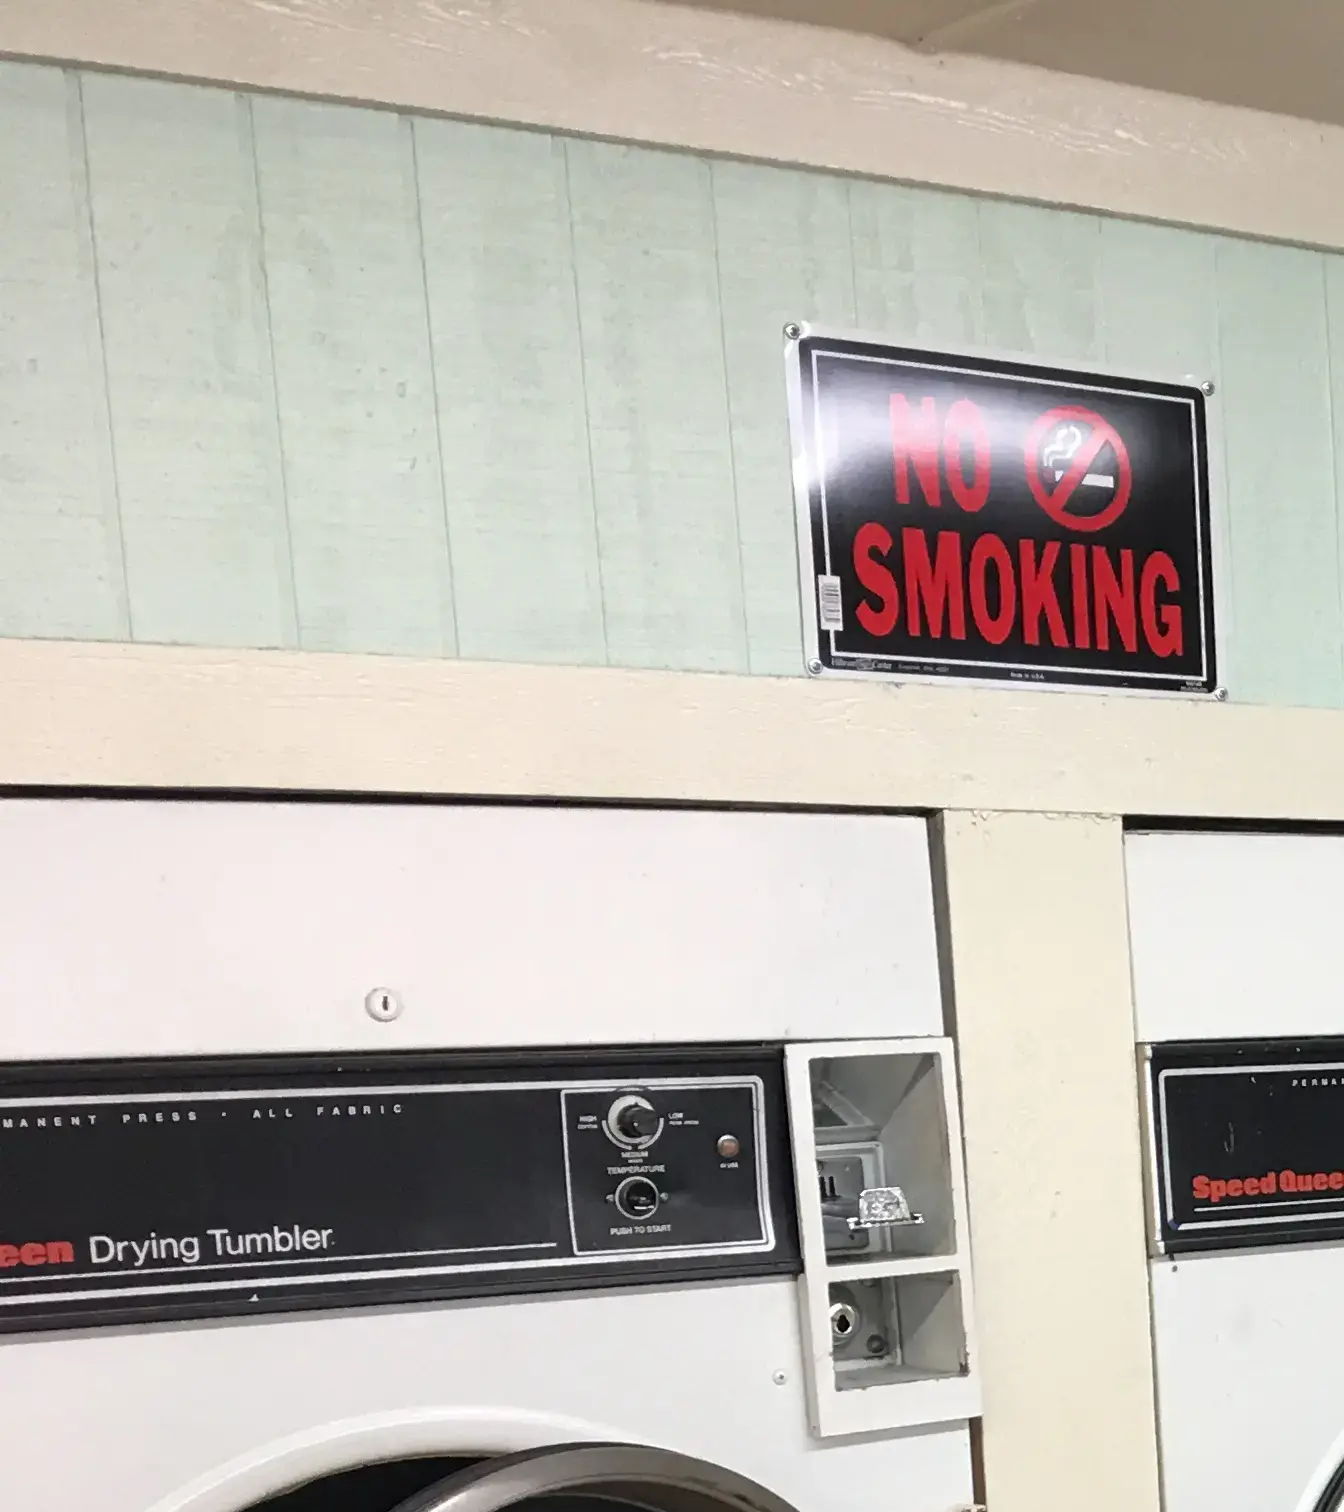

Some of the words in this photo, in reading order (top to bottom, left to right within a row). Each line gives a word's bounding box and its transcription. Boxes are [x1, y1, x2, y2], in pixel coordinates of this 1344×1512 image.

[889, 392, 992, 513] NO
[852, 522, 1184, 658] SMOKING
[2, 1114, 97, 1129] MANENT
[122, 1110, 197, 1123] PRESS
[253, 1107, 294, 1119] ALL
[316, 1104, 404, 1116] FABRIC
[607, 1165, 666, 1175] TEMPERATURE
[1192, 1171, 1277, 1203] Speed
[0, 1240, 75, 1267] een
[89, 1231, 201, 1266] Drying
[206, 1224, 334, 1256] Tumbler
[610, 1226, 633, 1235] PUSH
[646, 1224, 671, 1233] START
